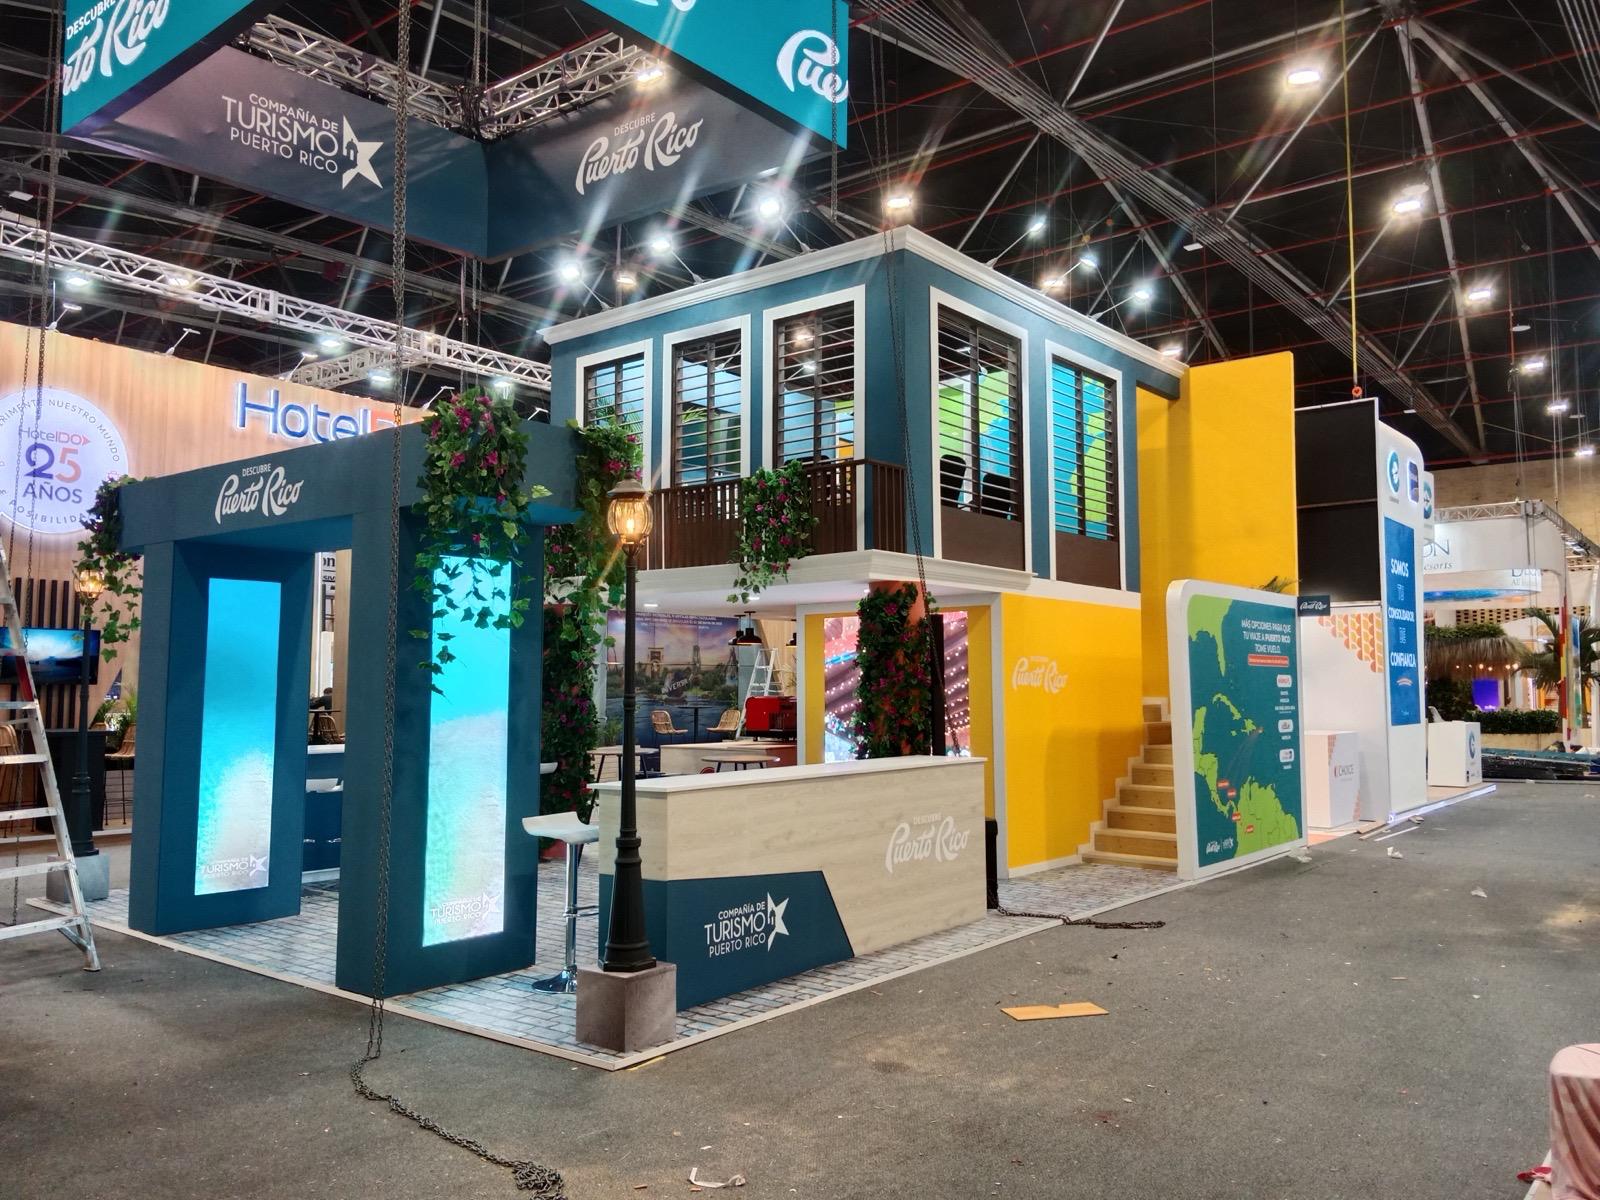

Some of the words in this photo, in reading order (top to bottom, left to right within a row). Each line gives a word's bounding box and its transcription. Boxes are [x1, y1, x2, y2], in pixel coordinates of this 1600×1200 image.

[100, 0, 170, 77] Rico
[221, 95, 338, 157] TURISMO
[249, 93, 318, 127] COMPAÑÍA
[321, 118, 339, 134] DE
[614, 112, 656, 137] DESCUBRE
[230, 127, 293, 159] PUERTO
[299, 150, 338, 174] RICO
[575, 129, 645, 195] Puerto
[644, 111, 704, 171] Rico
[48, 398, 97, 425] NUESTRO
[97, 423, 120, 463] MUNDO
[24, 443, 82, 484] 25
[242, 463, 272, 477] DESCUBRE
[22, 481, 83, 504] AÑOS
[214, 474, 264, 525] Puerto
[261, 466, 304, 517] Rico
[1390, 558, 1409, 578] SOMOS
[1390, 651, 1416, 668] CONFIANZA
[885, 822, 935, 873] Puerto
[935, 815, 971, 862] Rico
[200, 861, 249, 874] TURISMO
[430, 901, 482, 919] TURISMO
[717, 902, 755, 920] COMPAÑÍA
[755, 901, 767, 911] DE
[704, 911, 766, 945] TURISMO
[709, 938, 743, 958] PUERTO
[744, 932, 766, 949] RICO
